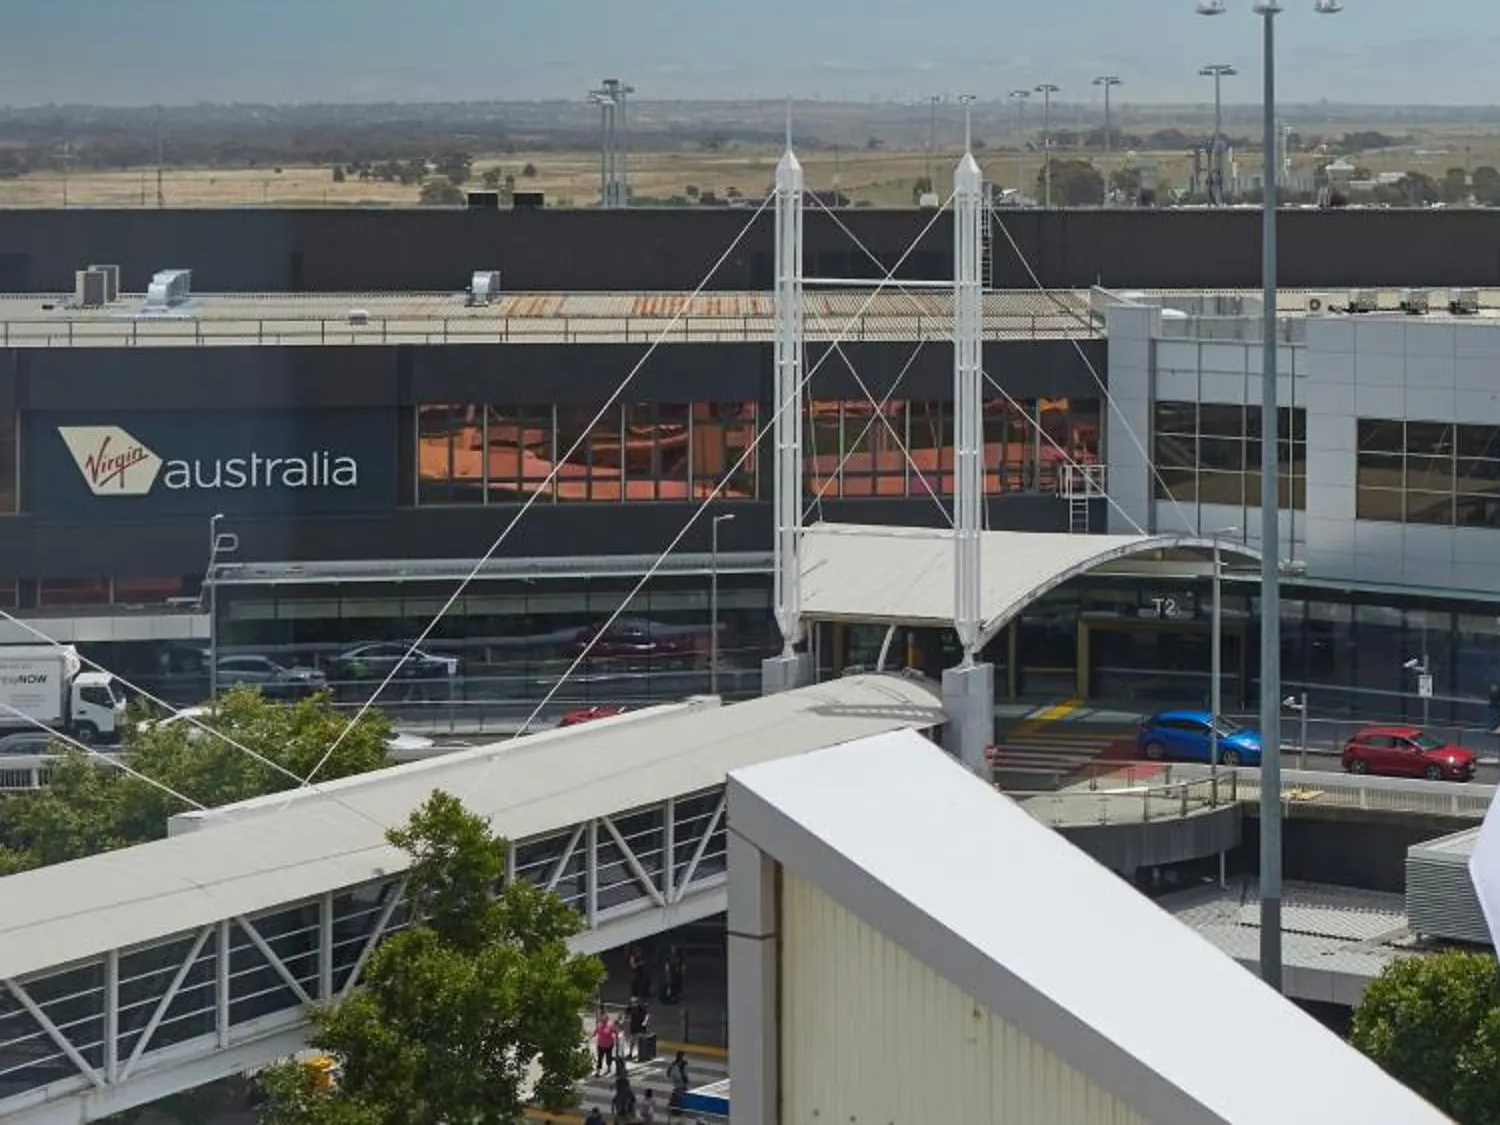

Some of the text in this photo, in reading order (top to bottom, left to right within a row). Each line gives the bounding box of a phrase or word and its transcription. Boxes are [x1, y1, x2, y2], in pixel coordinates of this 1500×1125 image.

[85, 435, 358, 489] Virgin australia
[1151, 597, 1177, 616] T2
